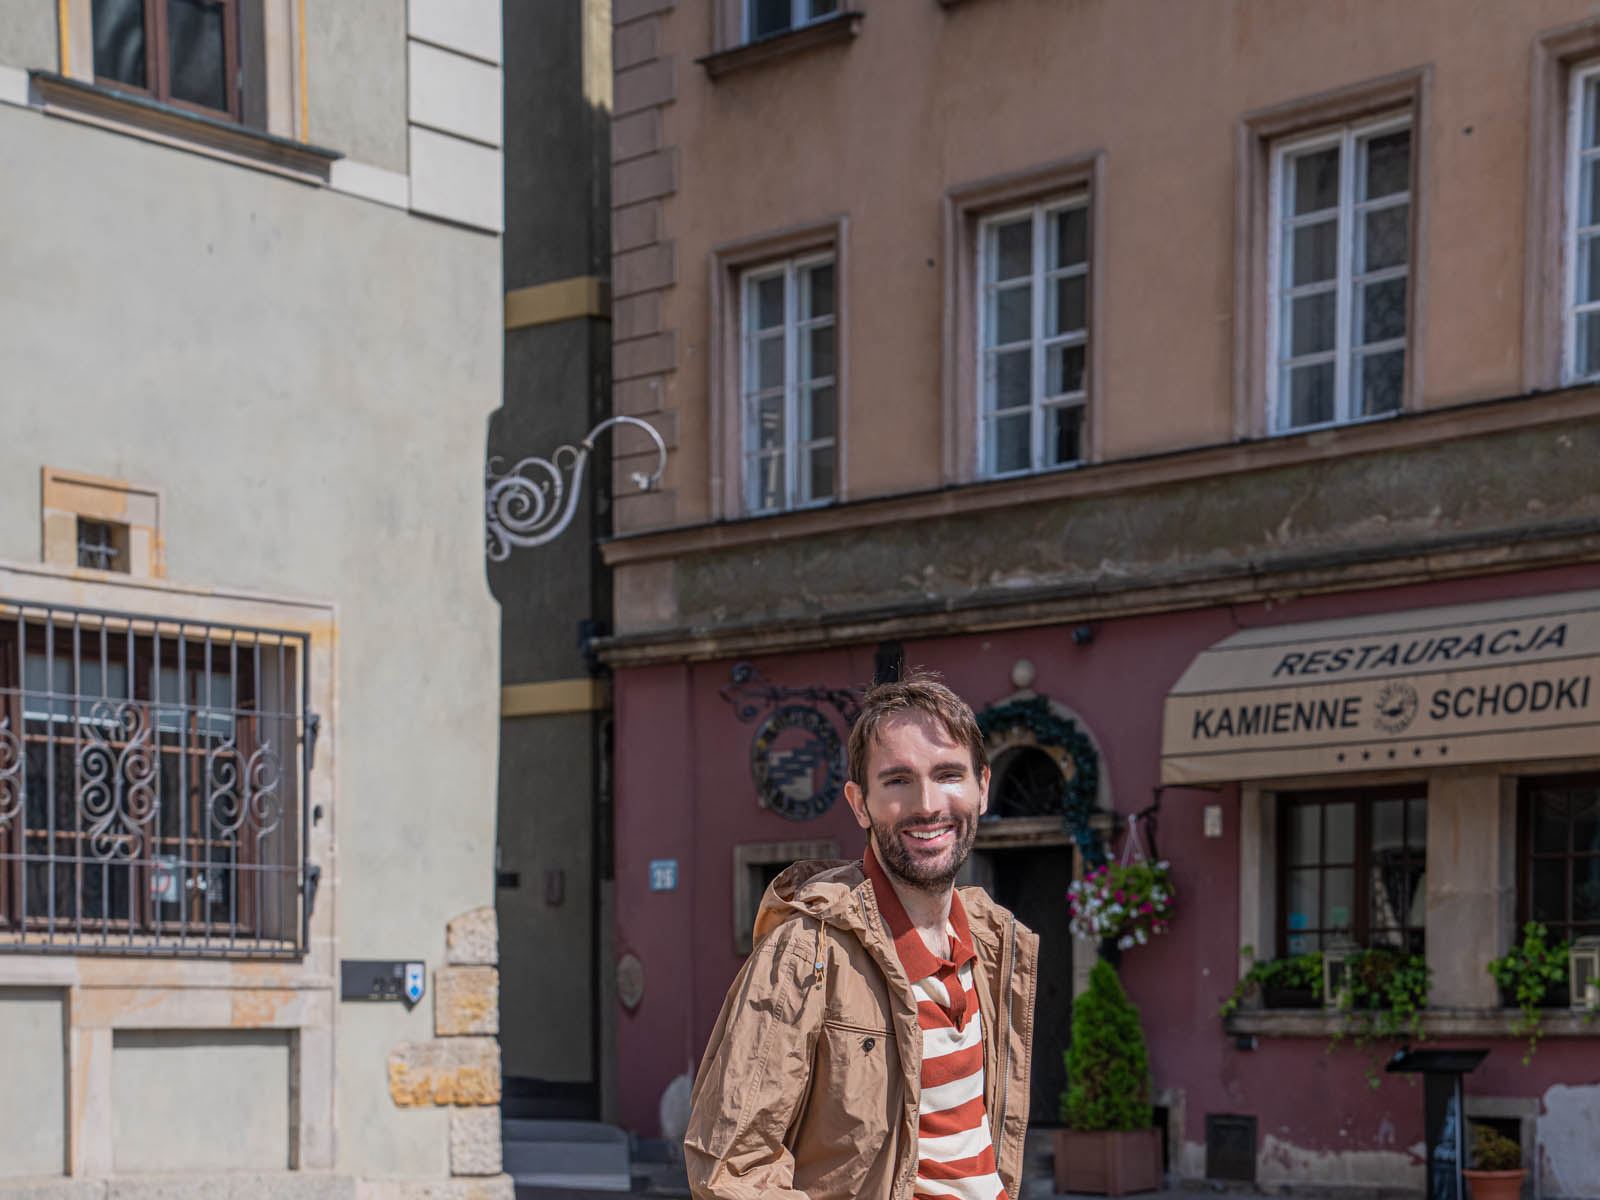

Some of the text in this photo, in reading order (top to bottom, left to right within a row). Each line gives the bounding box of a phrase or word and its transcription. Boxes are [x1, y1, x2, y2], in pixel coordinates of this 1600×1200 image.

[1272, 624, 1567, 678] RESTAURACJA
[1192, 697, 1362, 740] KAMIENNE
[1429, 675, 1591, 720] SCHODKI
